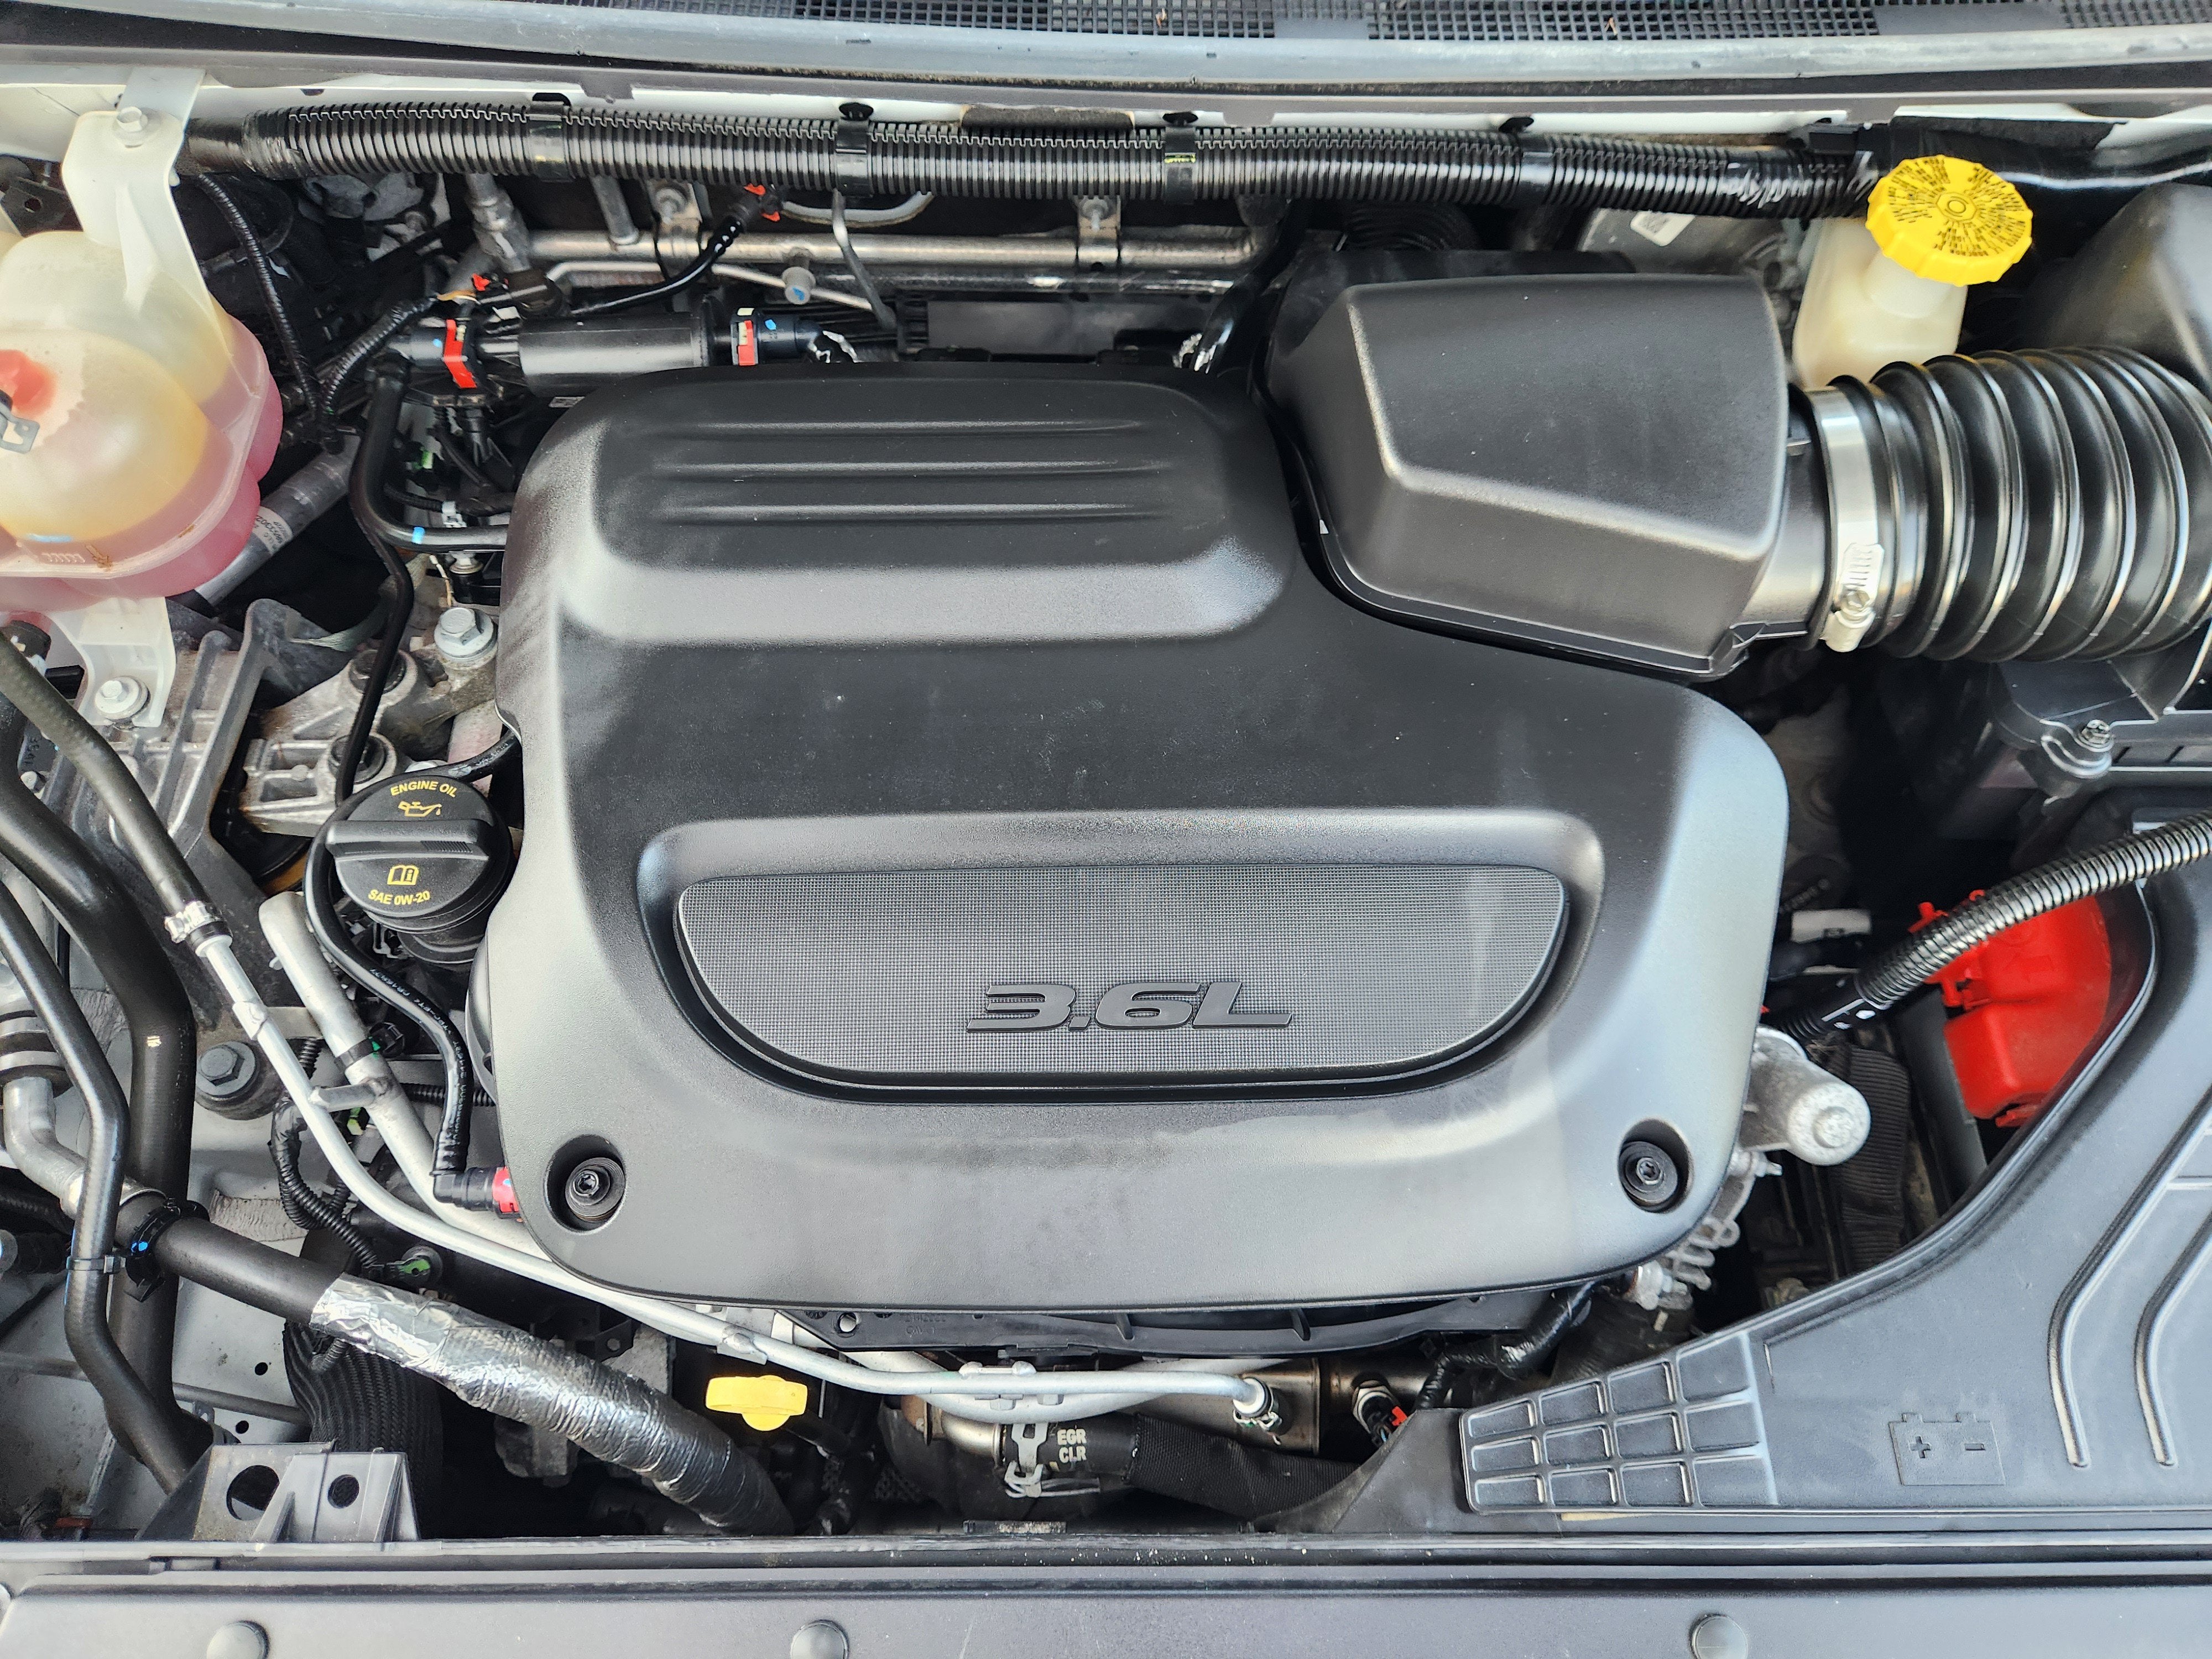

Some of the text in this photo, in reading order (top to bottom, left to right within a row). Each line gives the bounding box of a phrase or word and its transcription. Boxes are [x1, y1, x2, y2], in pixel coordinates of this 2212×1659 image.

[390, 781, 458, 797] ENGINE OIL
[368, 889, 430, 905] SAE 0W-20
[966, 980, 1293, 1033] 3.6L
[1057, 1428, 1087, 1446] EGR
[1058, 1447, 1087, 1463] CLR
